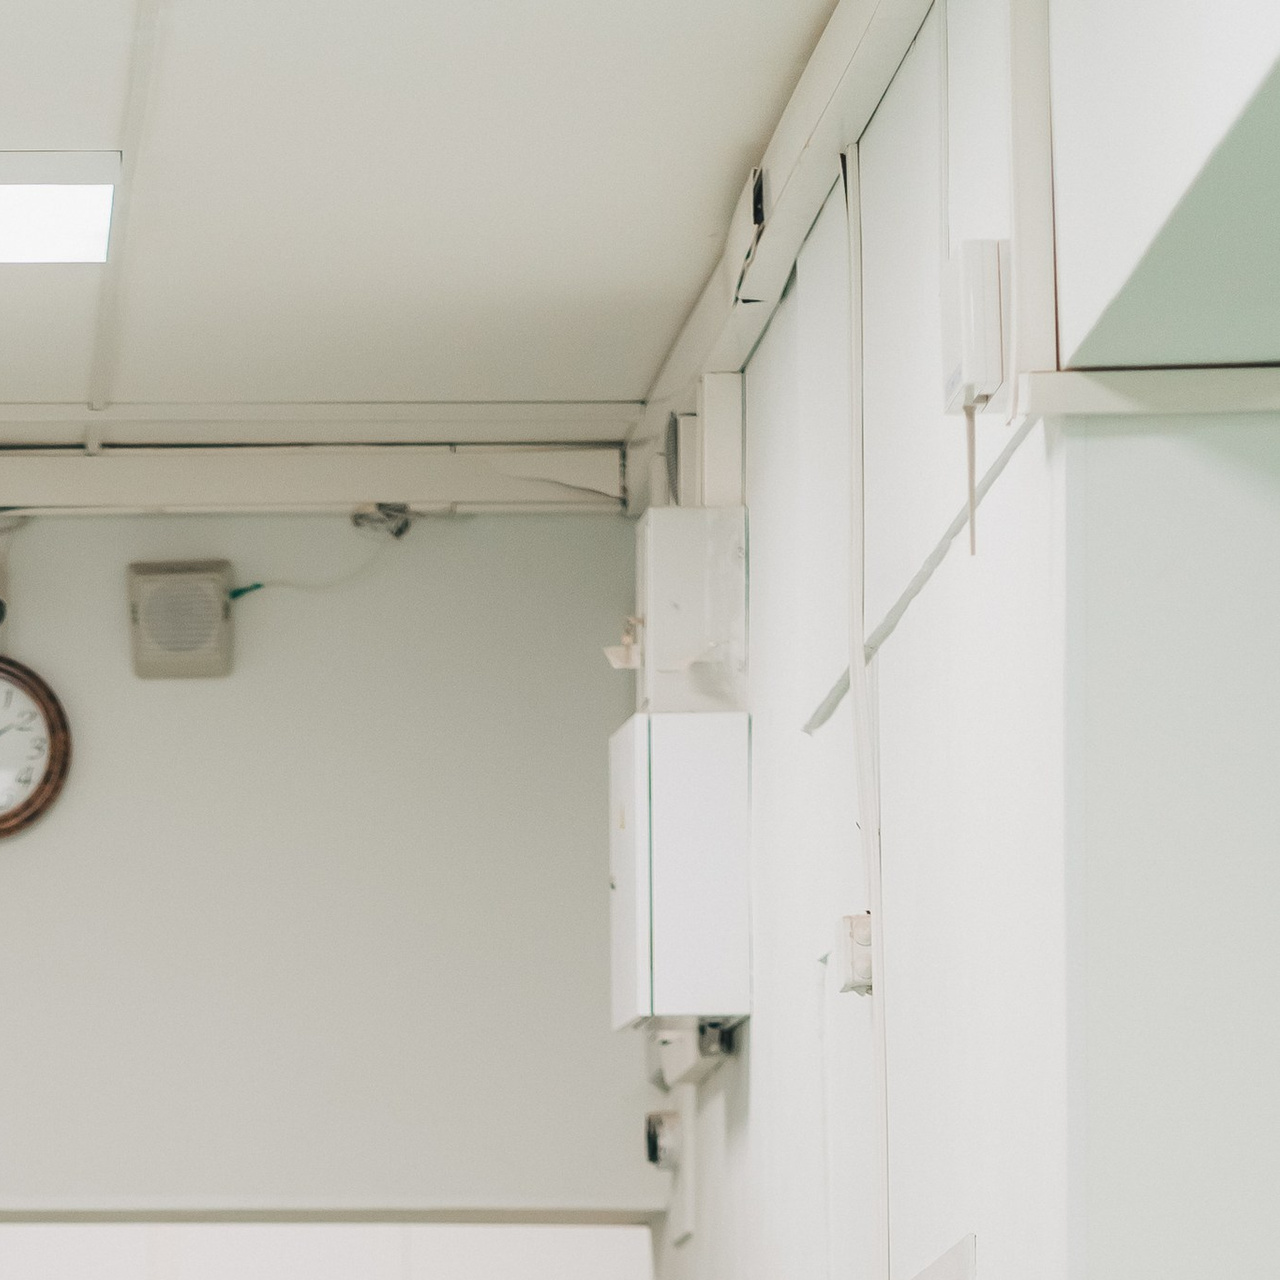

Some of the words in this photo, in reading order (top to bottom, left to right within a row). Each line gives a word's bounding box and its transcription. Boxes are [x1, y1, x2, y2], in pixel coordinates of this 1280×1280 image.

[3, 689, 14, 709] 1
[15, 711, 38, 731] 2
[26, 737, 47, 760] 3
[16, 766, 35, 788] 4
